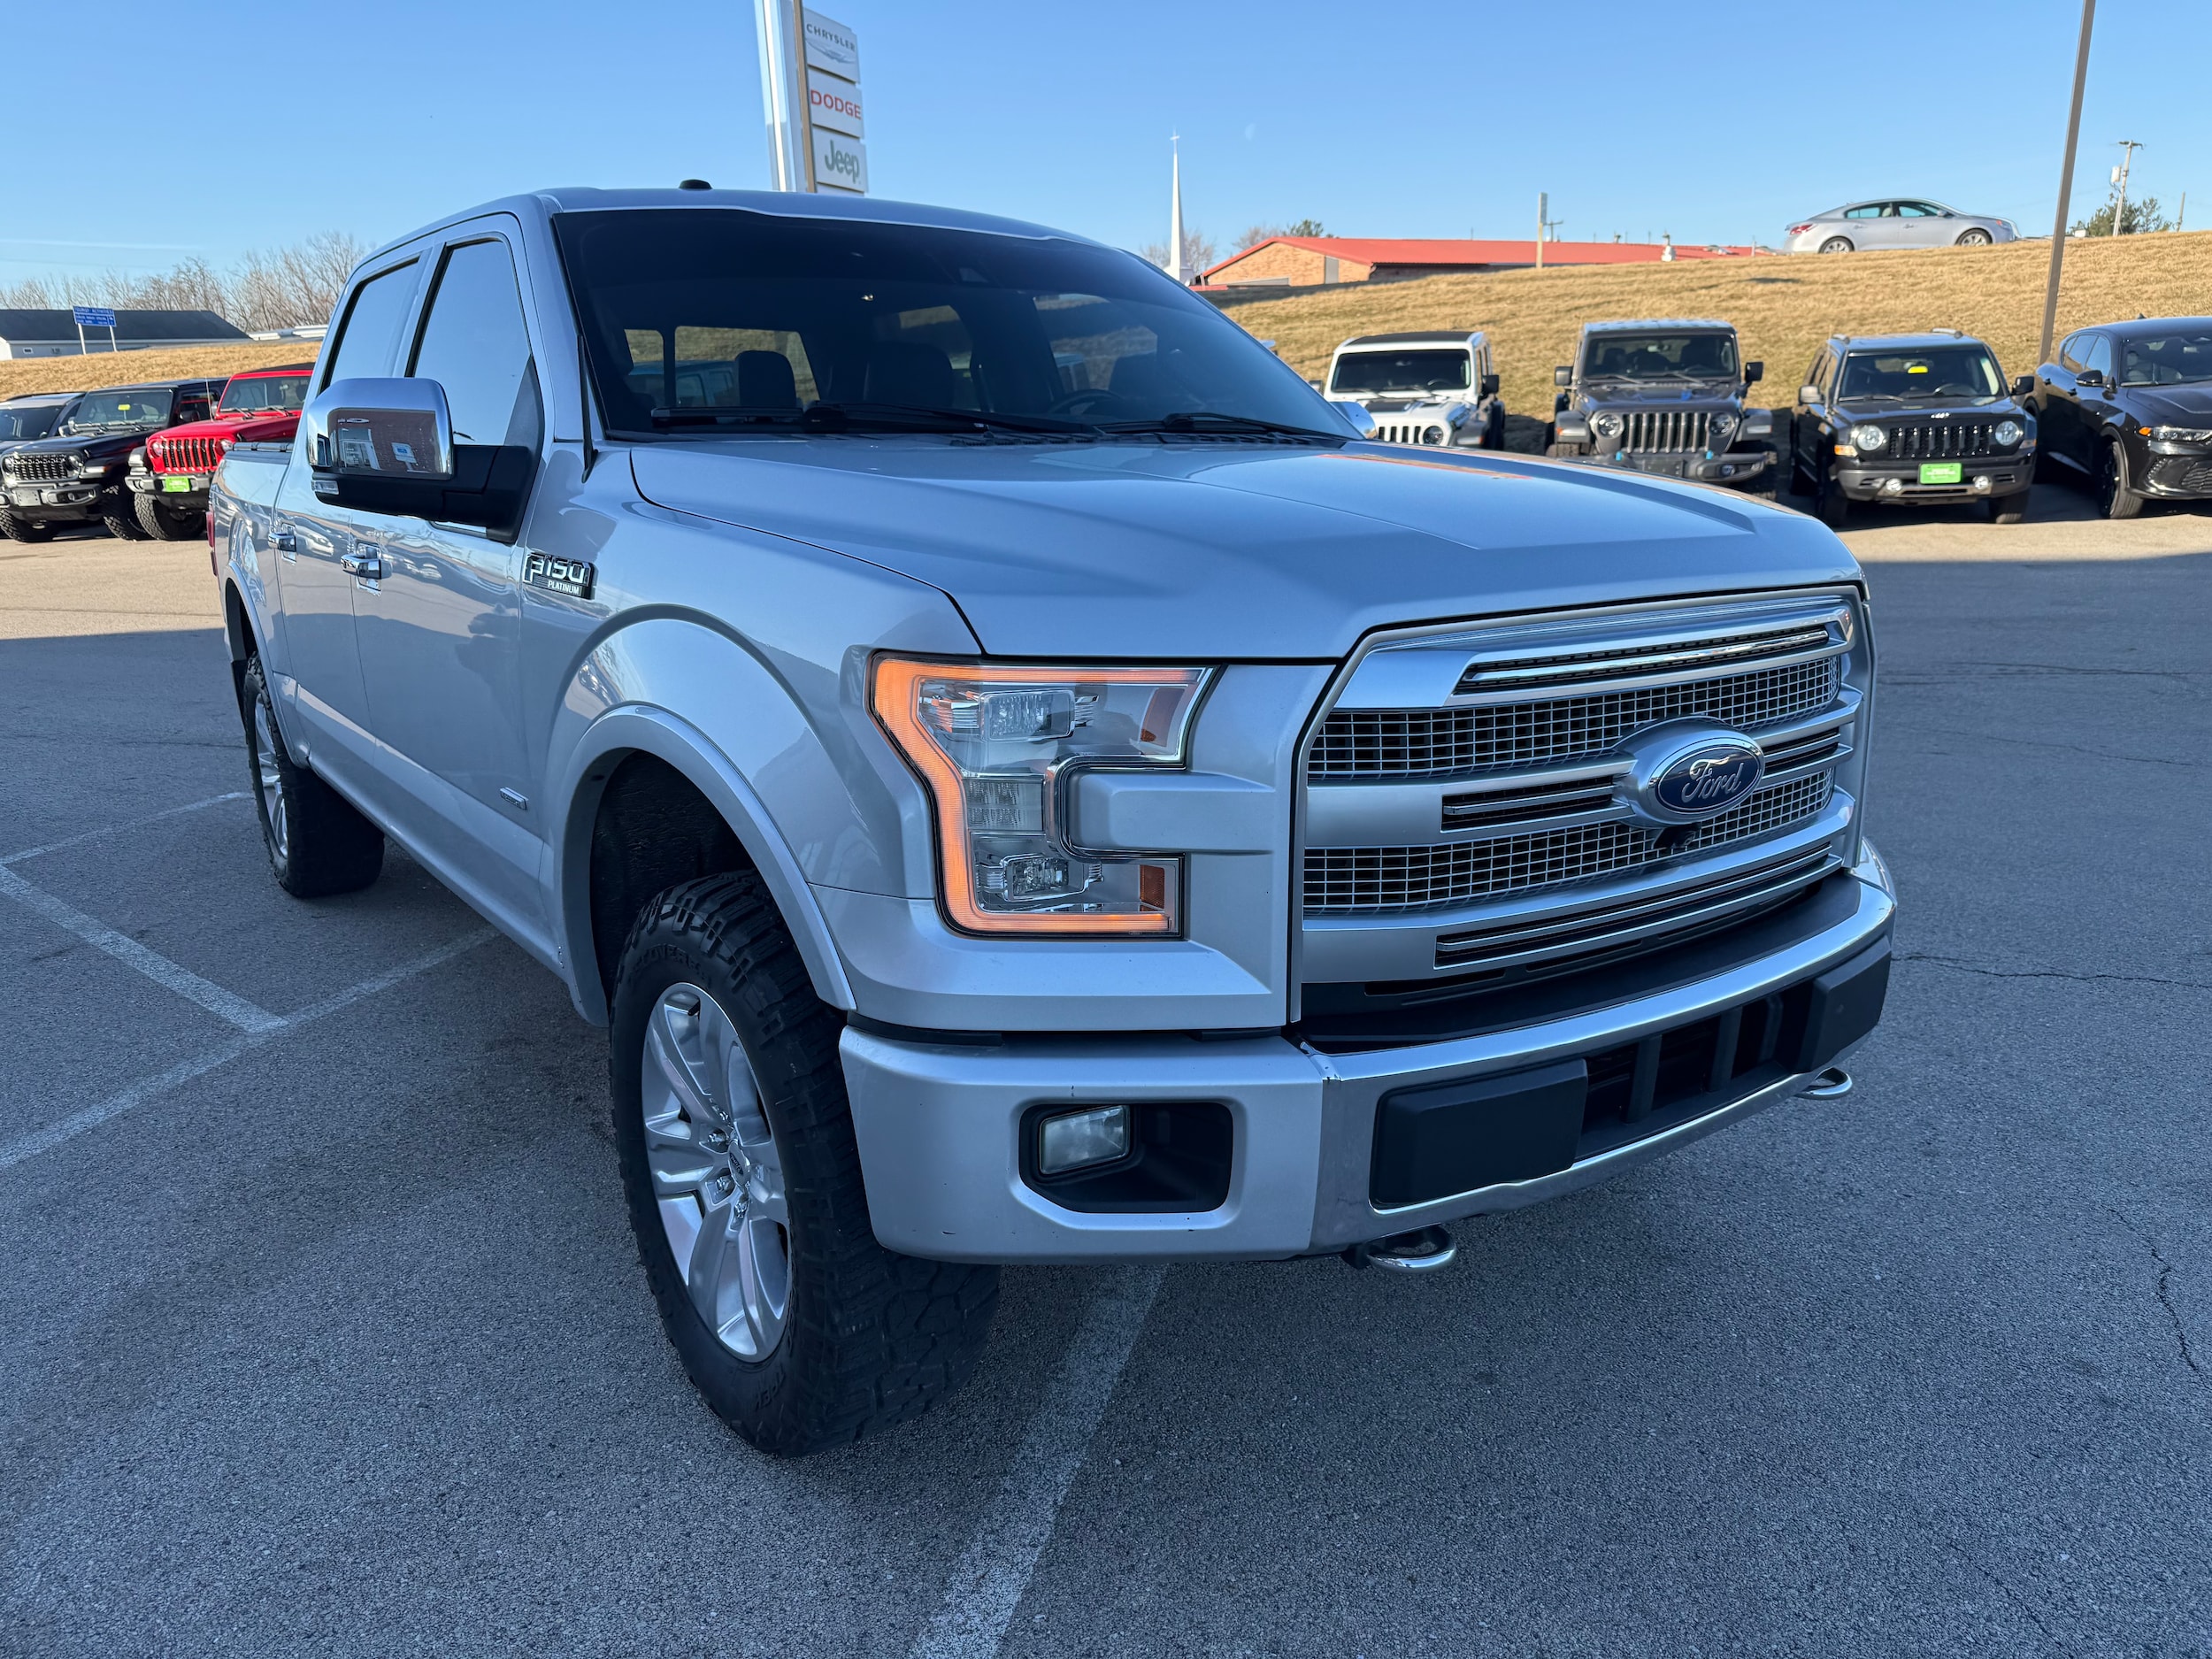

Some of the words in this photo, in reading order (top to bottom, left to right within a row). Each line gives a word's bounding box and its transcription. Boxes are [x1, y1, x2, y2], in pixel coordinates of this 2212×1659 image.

[806, 23, 856, 51] CHRYSLER
[810, 89, 862, 120] DODGE
[825, 139, 860, 184] Jeep
[548, 580, 580, 595] PLATINUM
[1681, 753, 1744, 803] Ford
